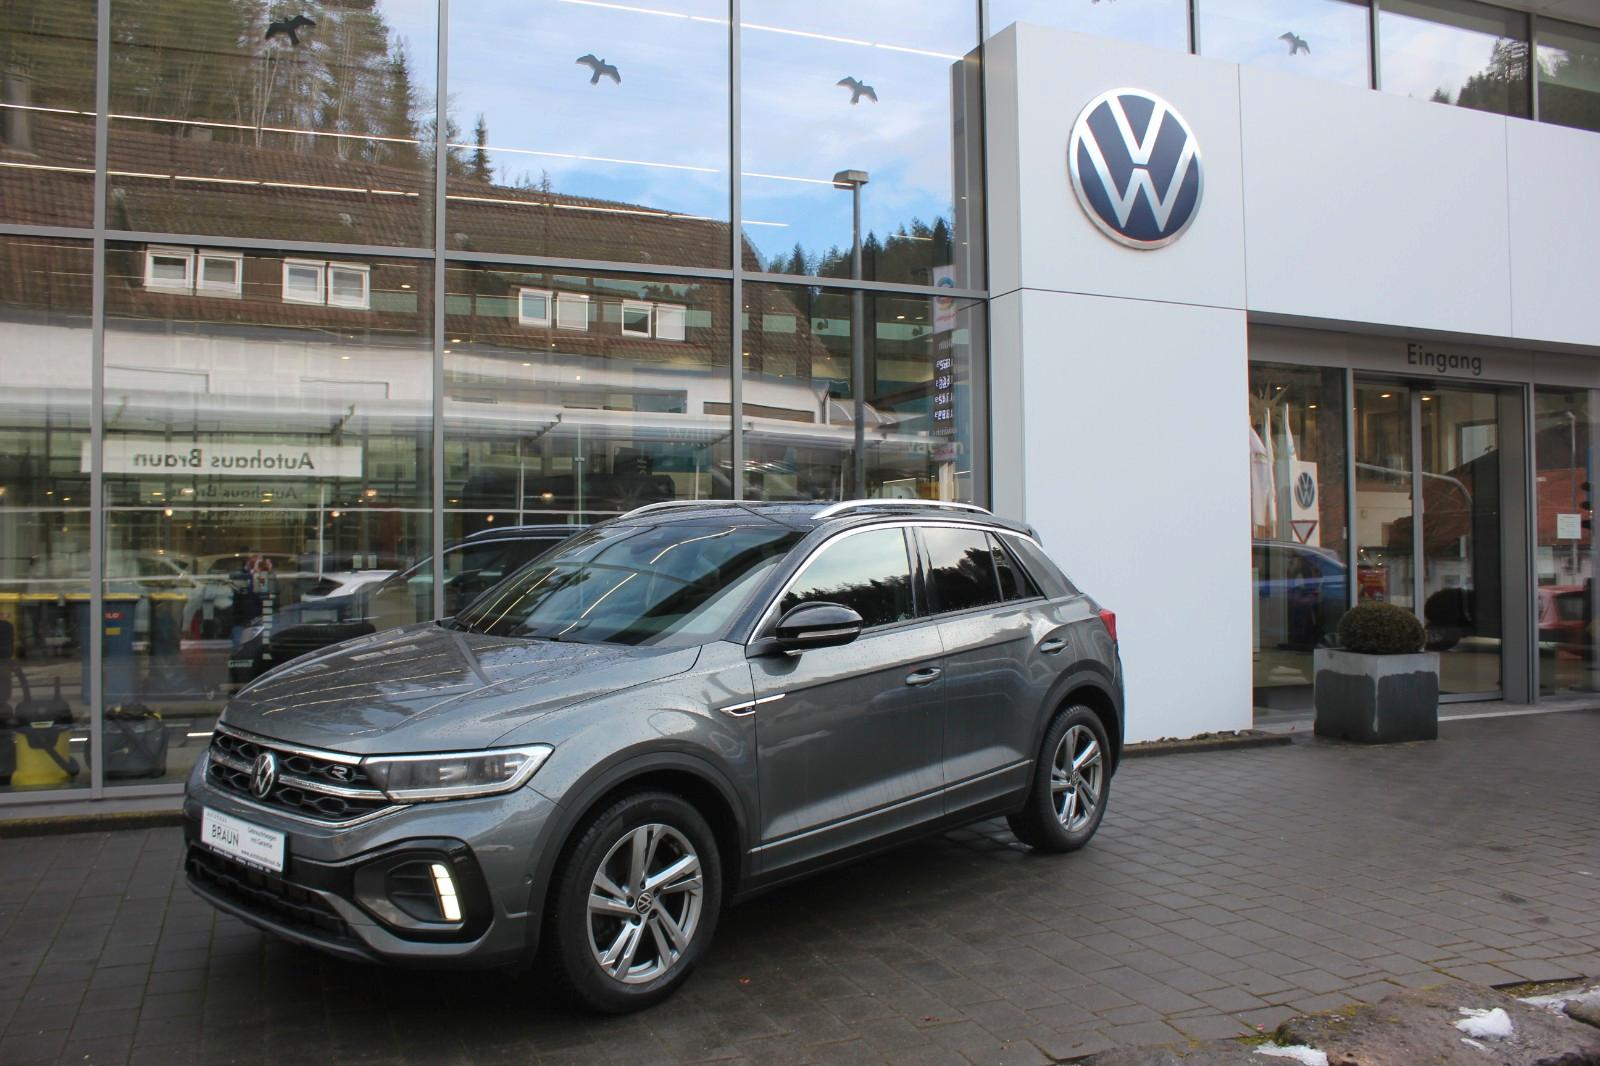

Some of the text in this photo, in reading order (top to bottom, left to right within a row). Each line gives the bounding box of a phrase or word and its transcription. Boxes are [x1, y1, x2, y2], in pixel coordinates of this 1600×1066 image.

[1070, 88, 1203, 243] VW
[1407, 343, 1482, 376] Eingang
[212, 824, 240, 847] BRAUN
